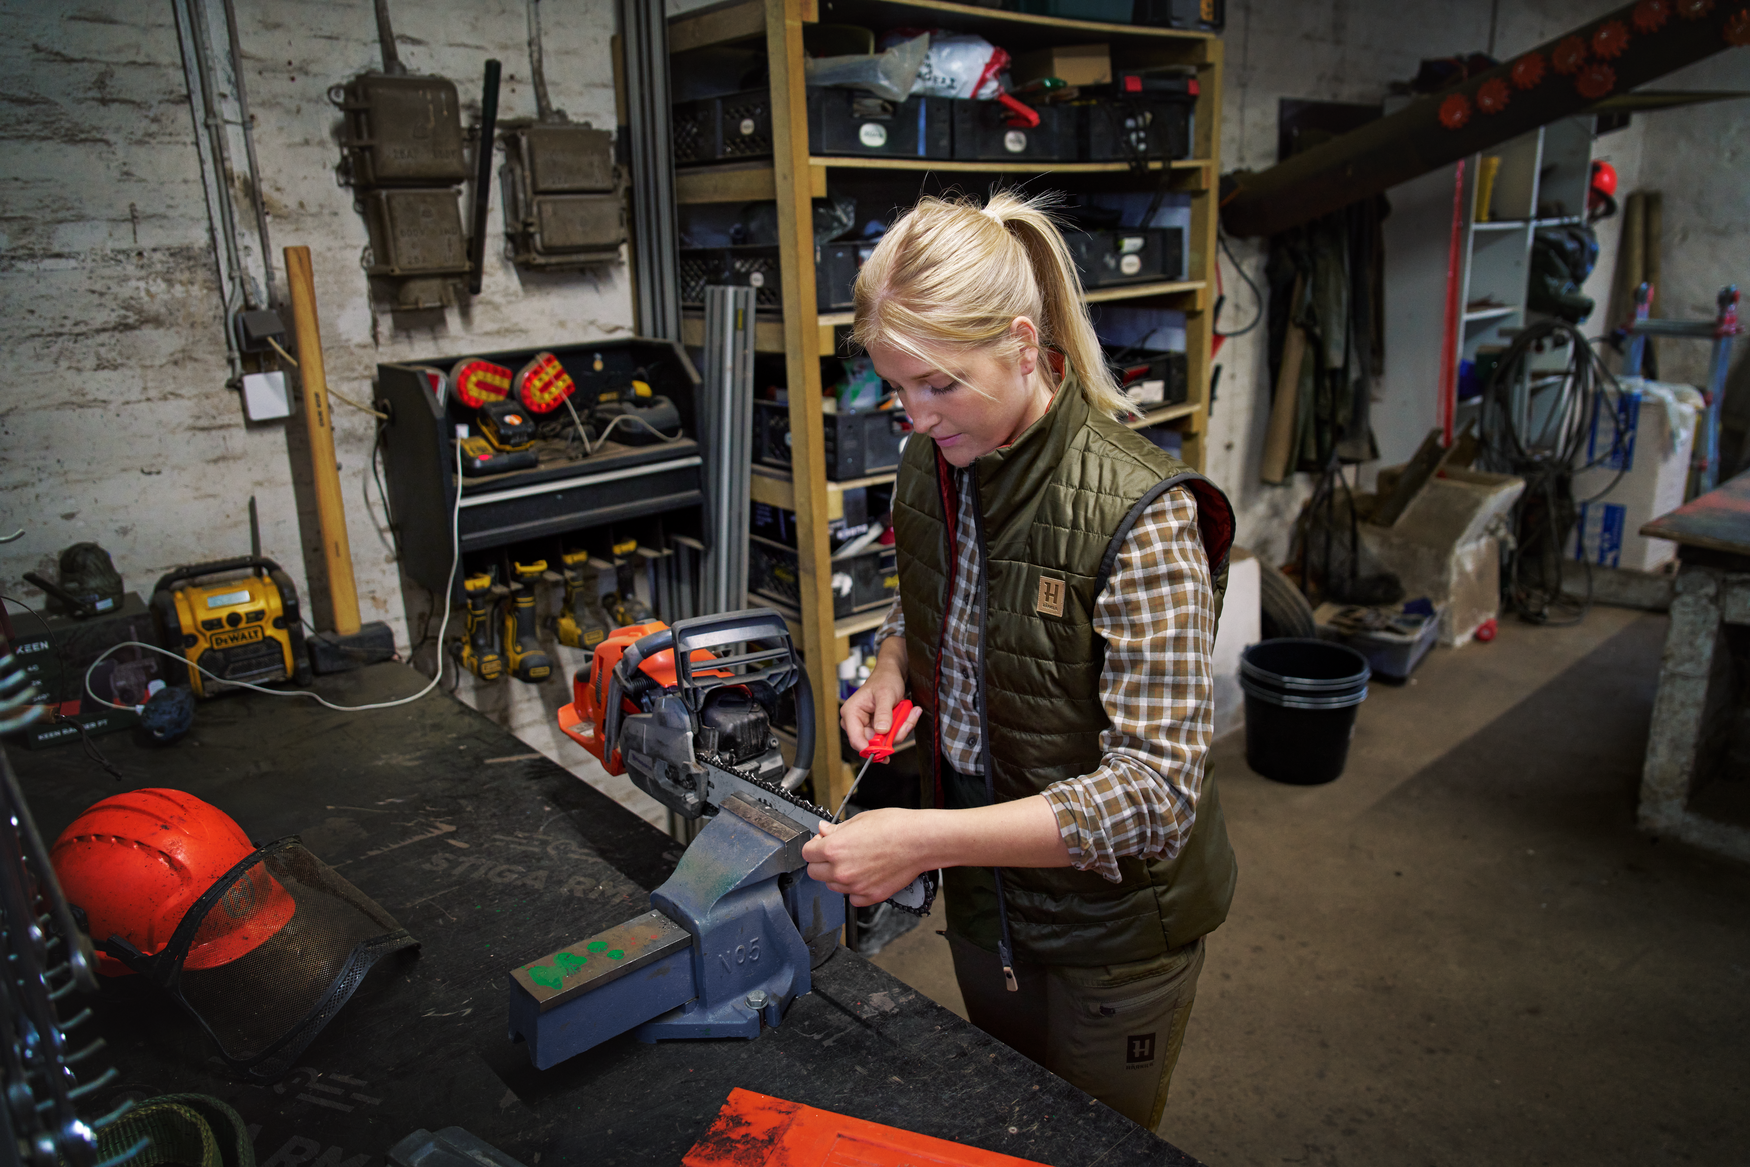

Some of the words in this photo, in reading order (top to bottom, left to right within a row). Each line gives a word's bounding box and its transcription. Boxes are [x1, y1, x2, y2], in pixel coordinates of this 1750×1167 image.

[15, 640, 49, 655] KEEN
[37, 729, 62, 742] KEEN
[61, 720, 97, 736] RAER
[421, 852, 551, 891] STIGA
